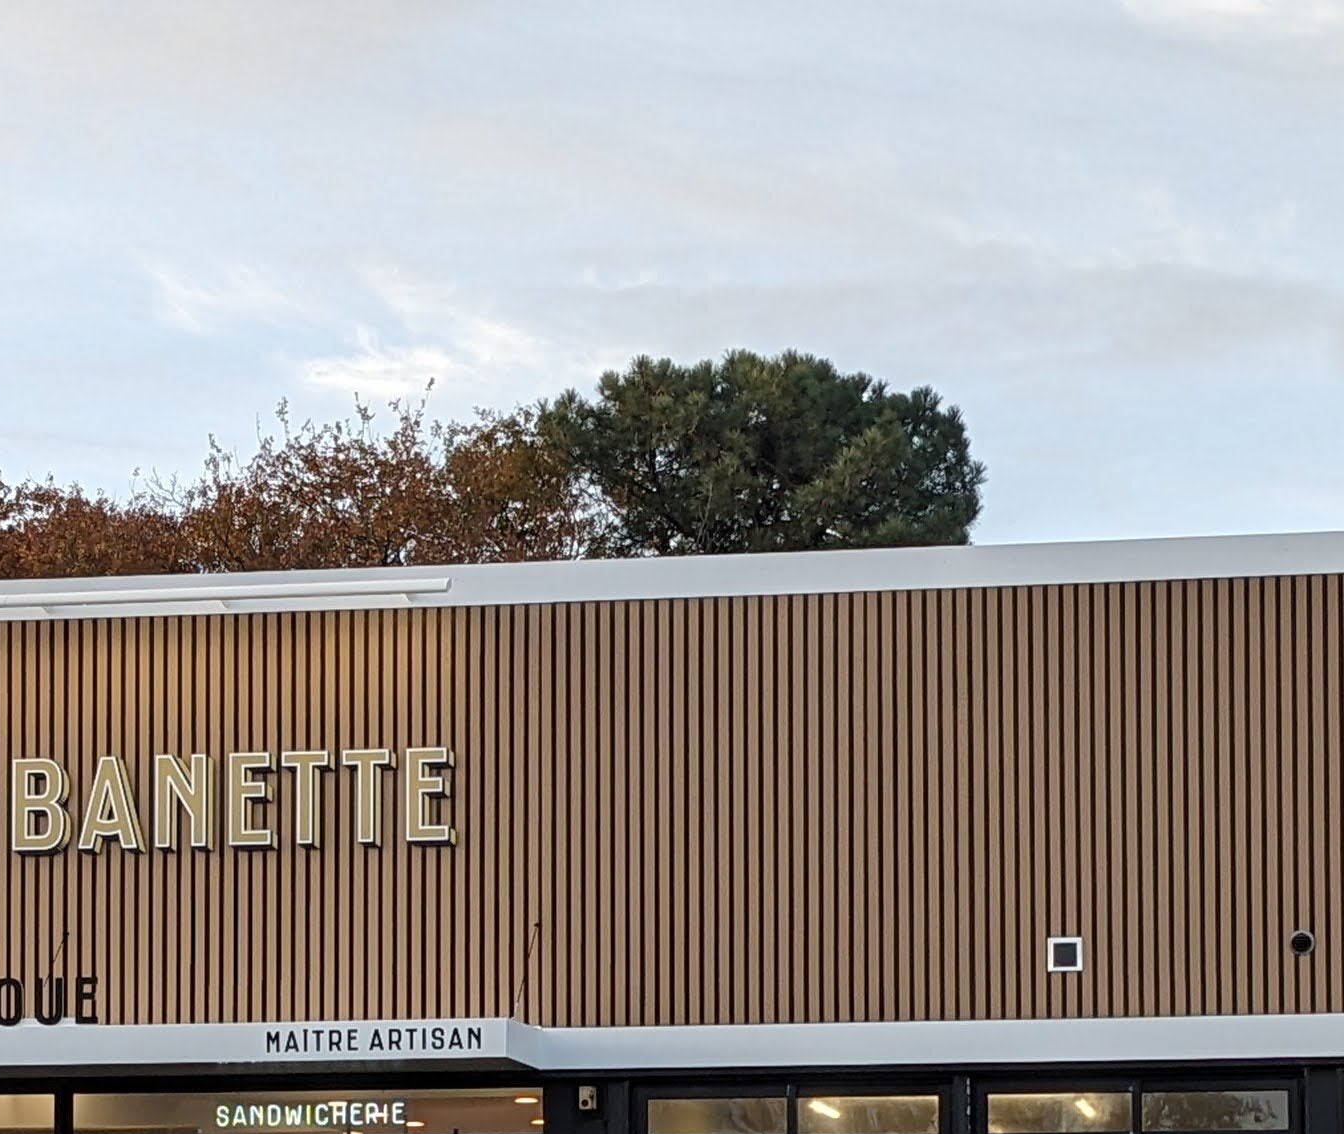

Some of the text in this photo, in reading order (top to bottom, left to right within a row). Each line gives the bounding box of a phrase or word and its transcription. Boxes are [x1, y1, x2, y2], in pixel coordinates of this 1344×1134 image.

[11, 747, 458, 854] BANETTE
[265, 1026, 483, 1054] MAÎTRE ARTISAN
[215, 1101, 407, 1128] SANDWICHERIE
